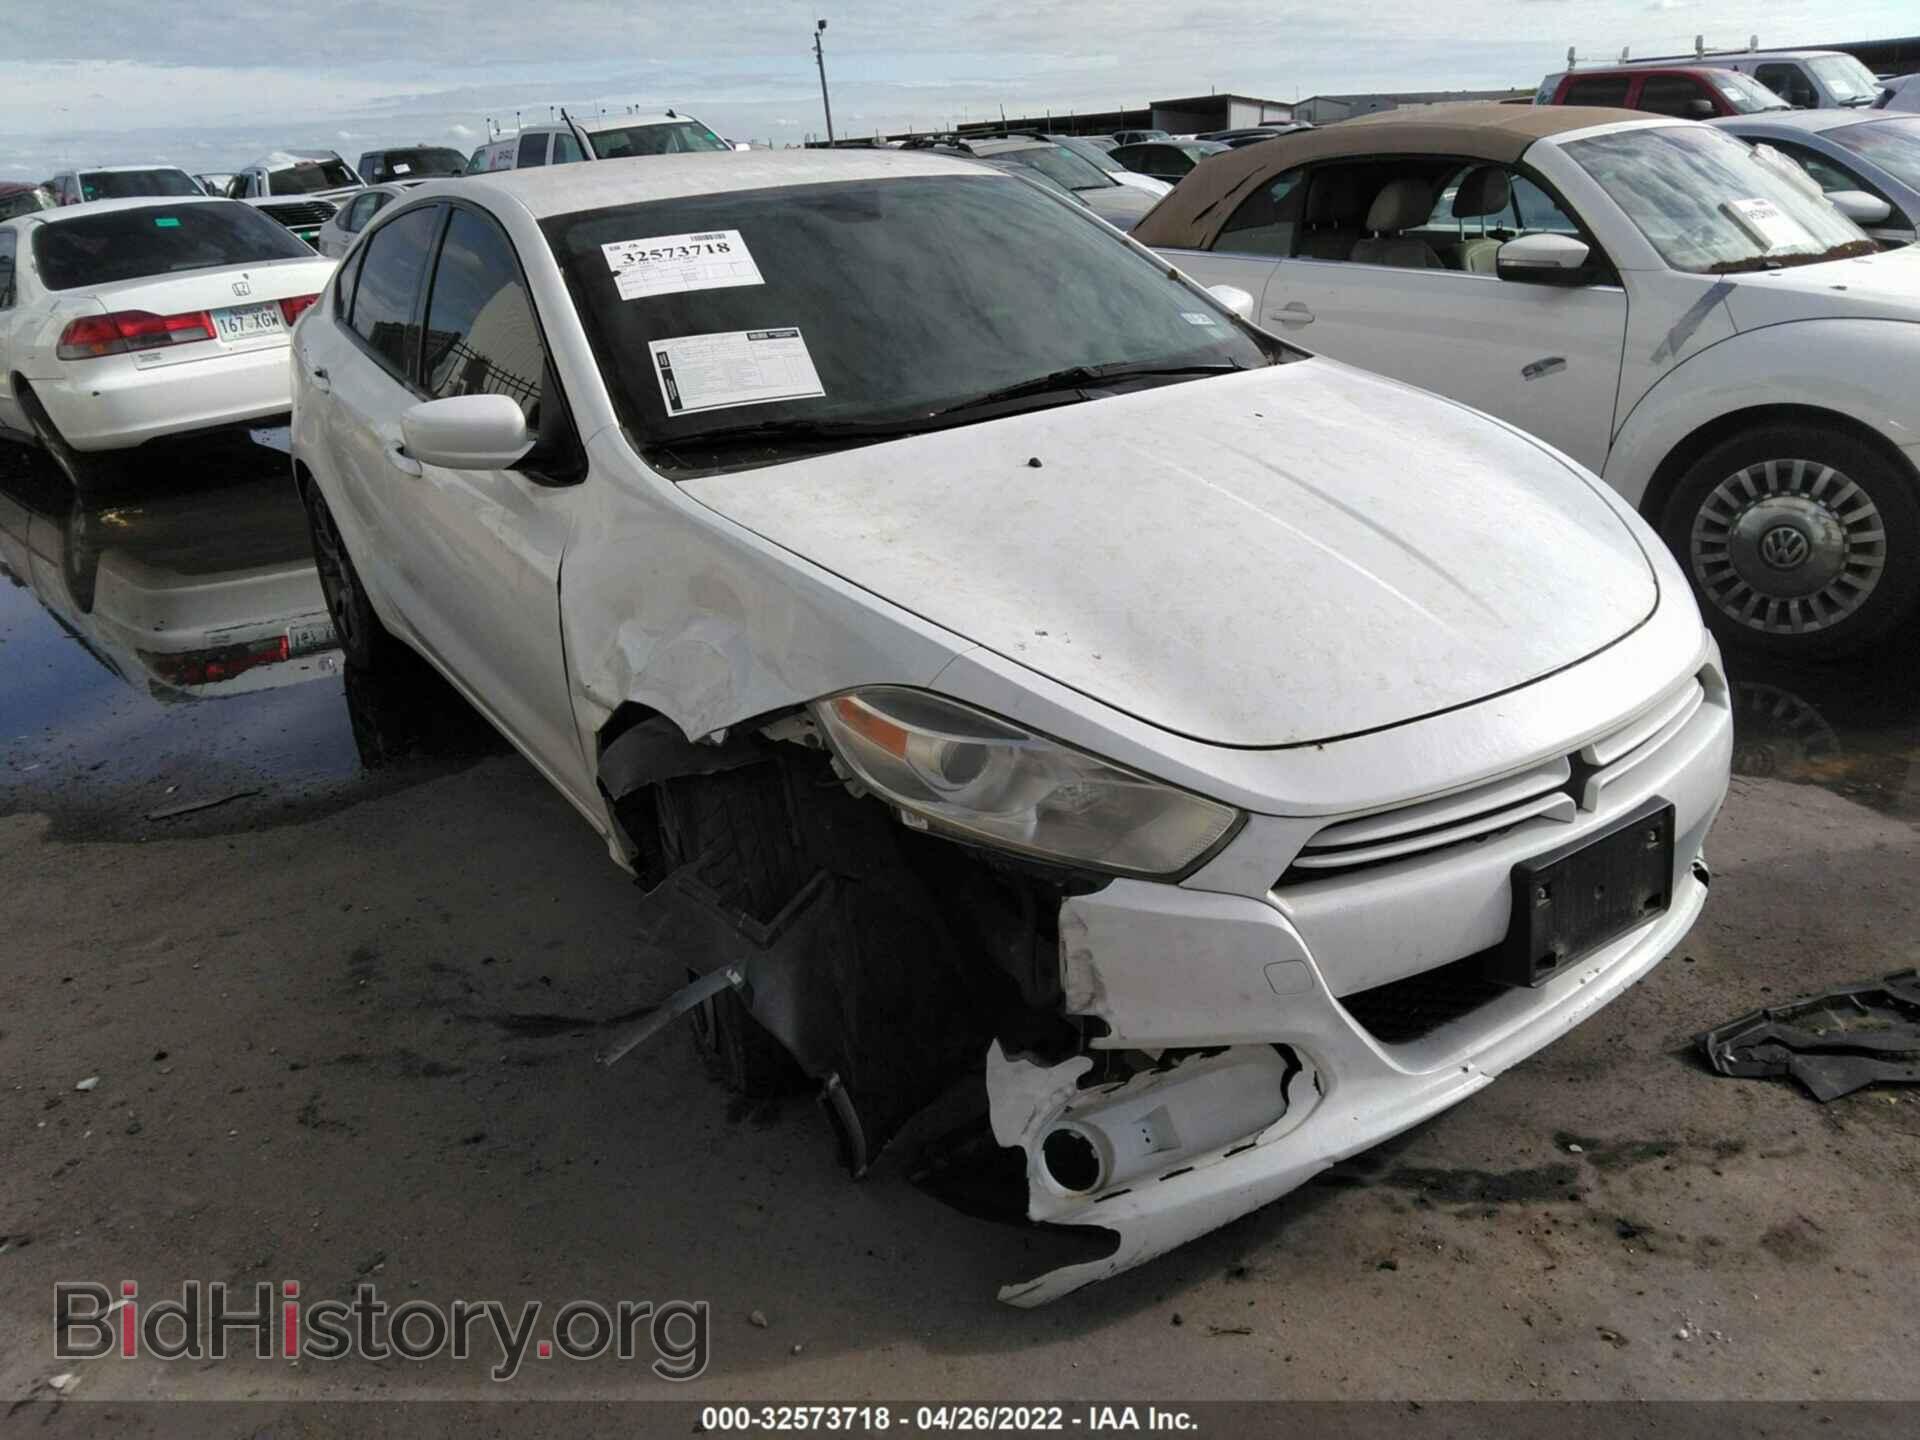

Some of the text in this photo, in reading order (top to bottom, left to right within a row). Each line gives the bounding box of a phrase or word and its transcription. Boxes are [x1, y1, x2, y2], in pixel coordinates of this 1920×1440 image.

[622, 242, 731, 264] 32573718
[220, 311, 280, 334] 167 XGW
